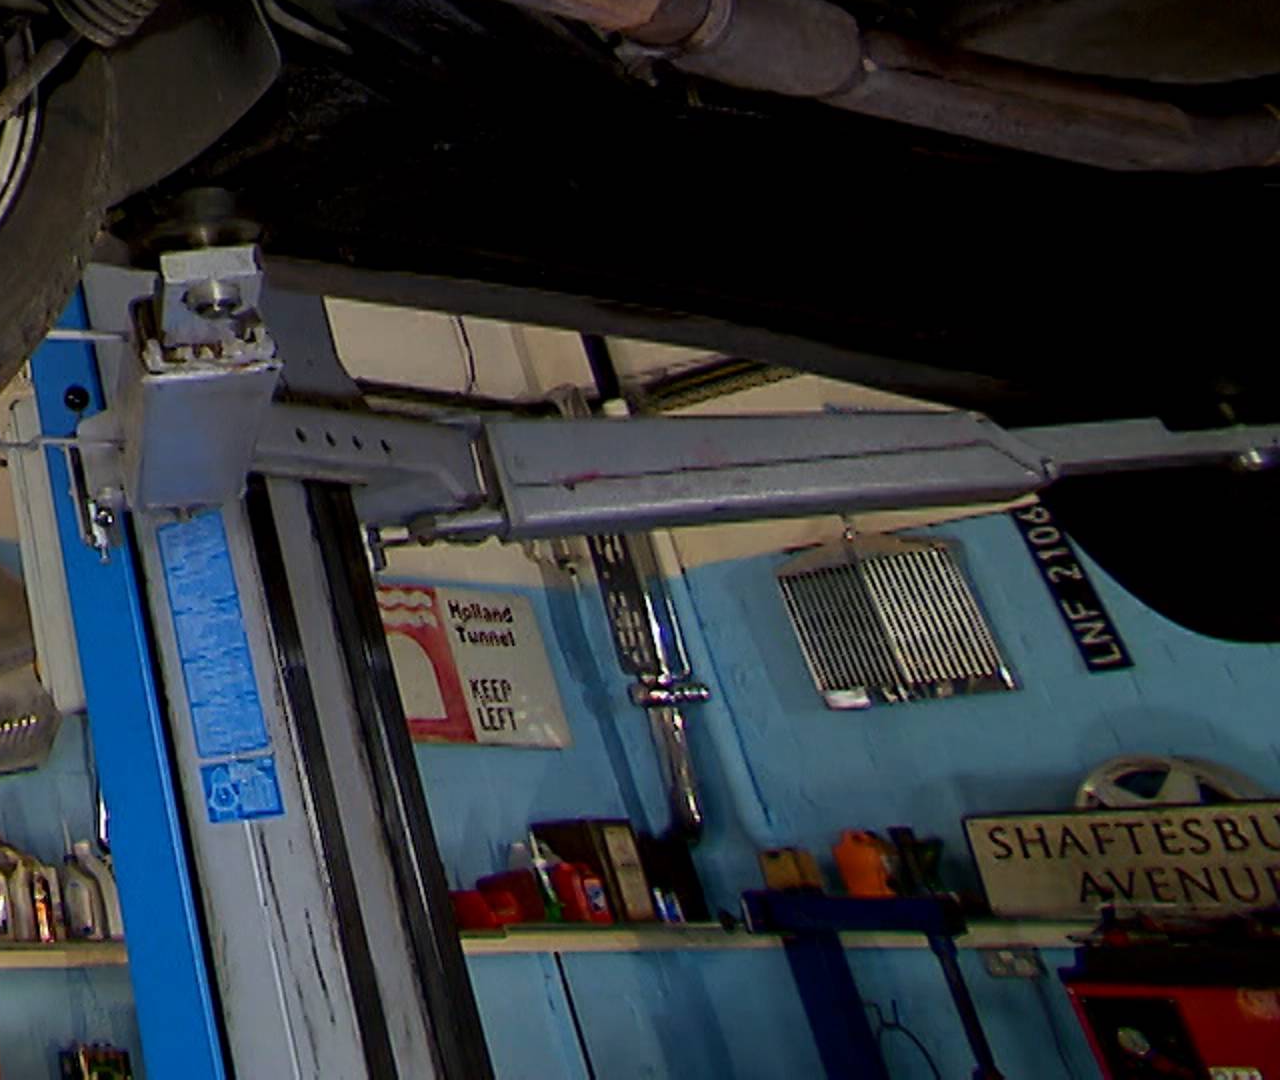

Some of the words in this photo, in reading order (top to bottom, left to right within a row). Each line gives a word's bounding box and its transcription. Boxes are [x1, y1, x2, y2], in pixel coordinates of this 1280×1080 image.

[455, 626, 516, 647] Tunnel
[1060, 599, 1123, 663] LNF
[469, 678, 512, 703] KEEP
[477, 707, 517, 731] LEFT
